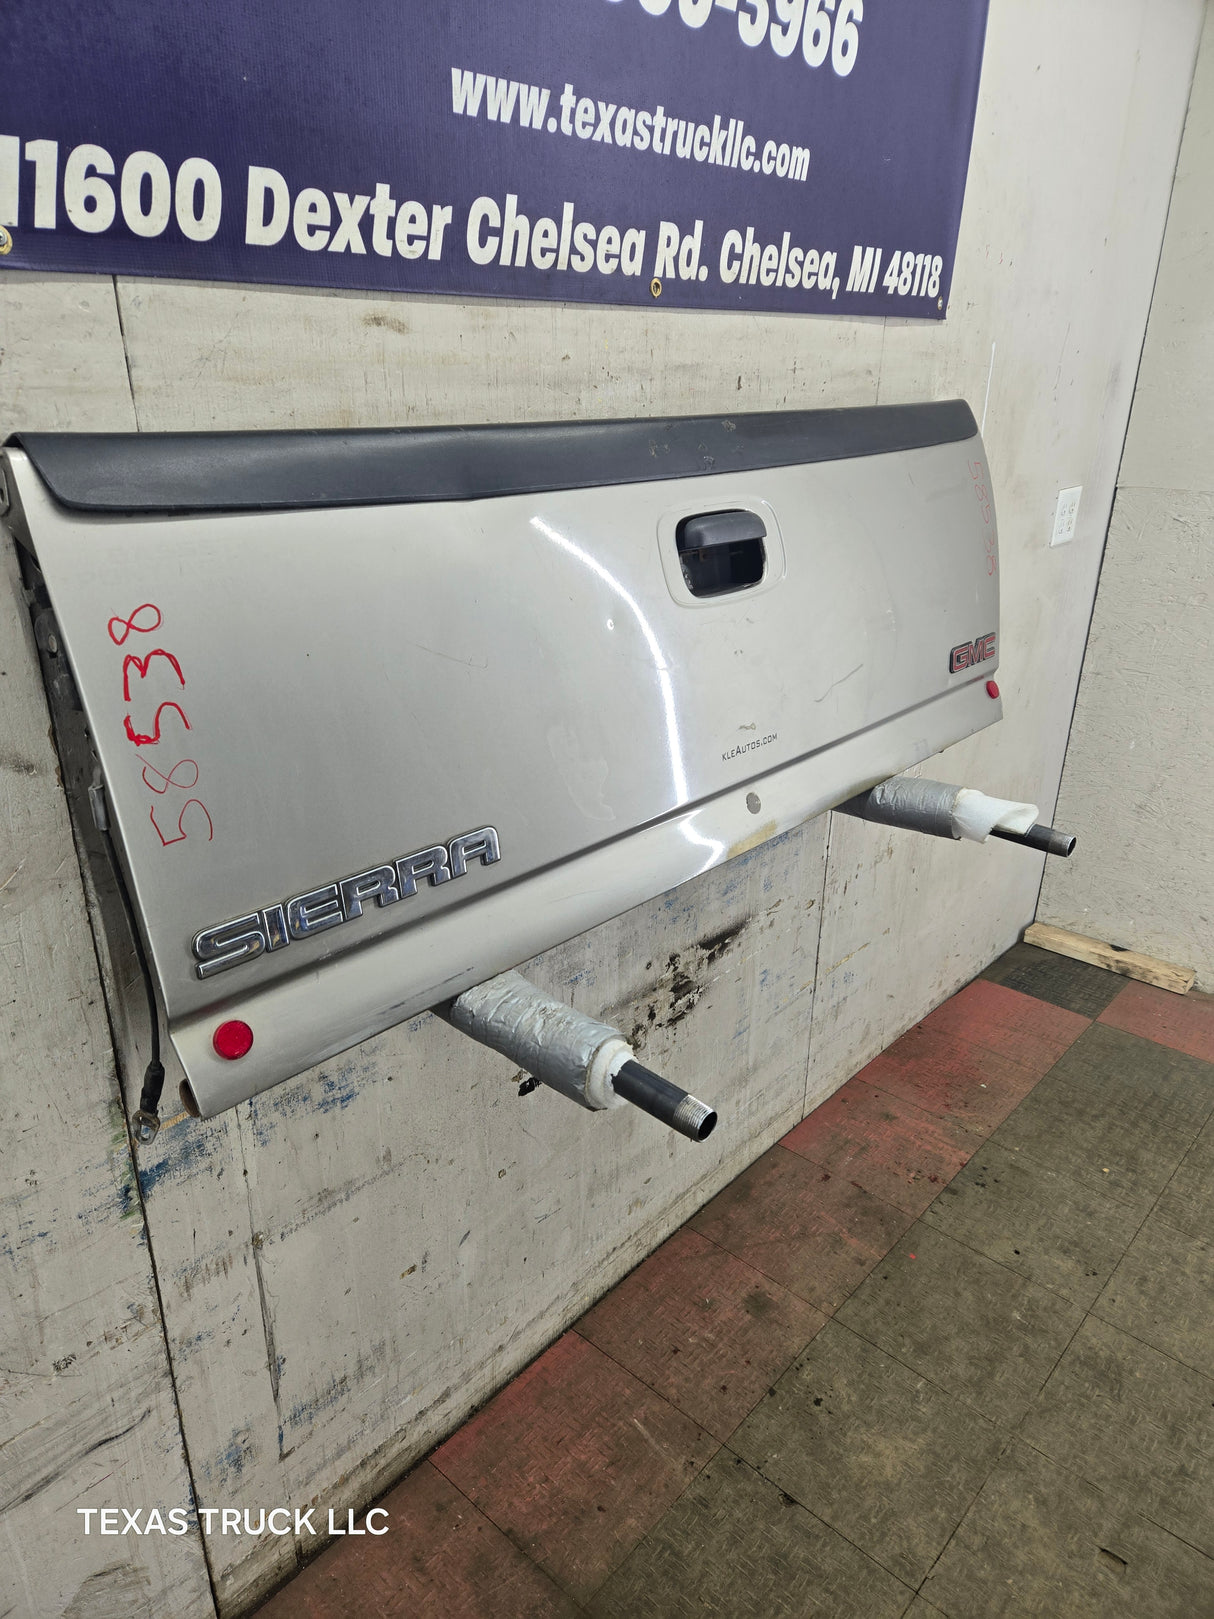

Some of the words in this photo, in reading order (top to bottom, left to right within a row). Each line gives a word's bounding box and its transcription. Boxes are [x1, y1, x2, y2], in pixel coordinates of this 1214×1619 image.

[451, 67, 811, 182] www.texastruckllc.com
[245, 165, 453, 261] Dexter
[466, 193, 646, 278] Chelsea
[653, 219, 708, 282] Rd.
[719, 226, 840, 300] Chelsea,
[845, 245, 883, 293] MI
[883, 250, 943, 298] 48118
[949, 632, 996, 674] GMC
[107, 603, 213, 846] 58538
[191, 825, 501, 980] SIERRA
